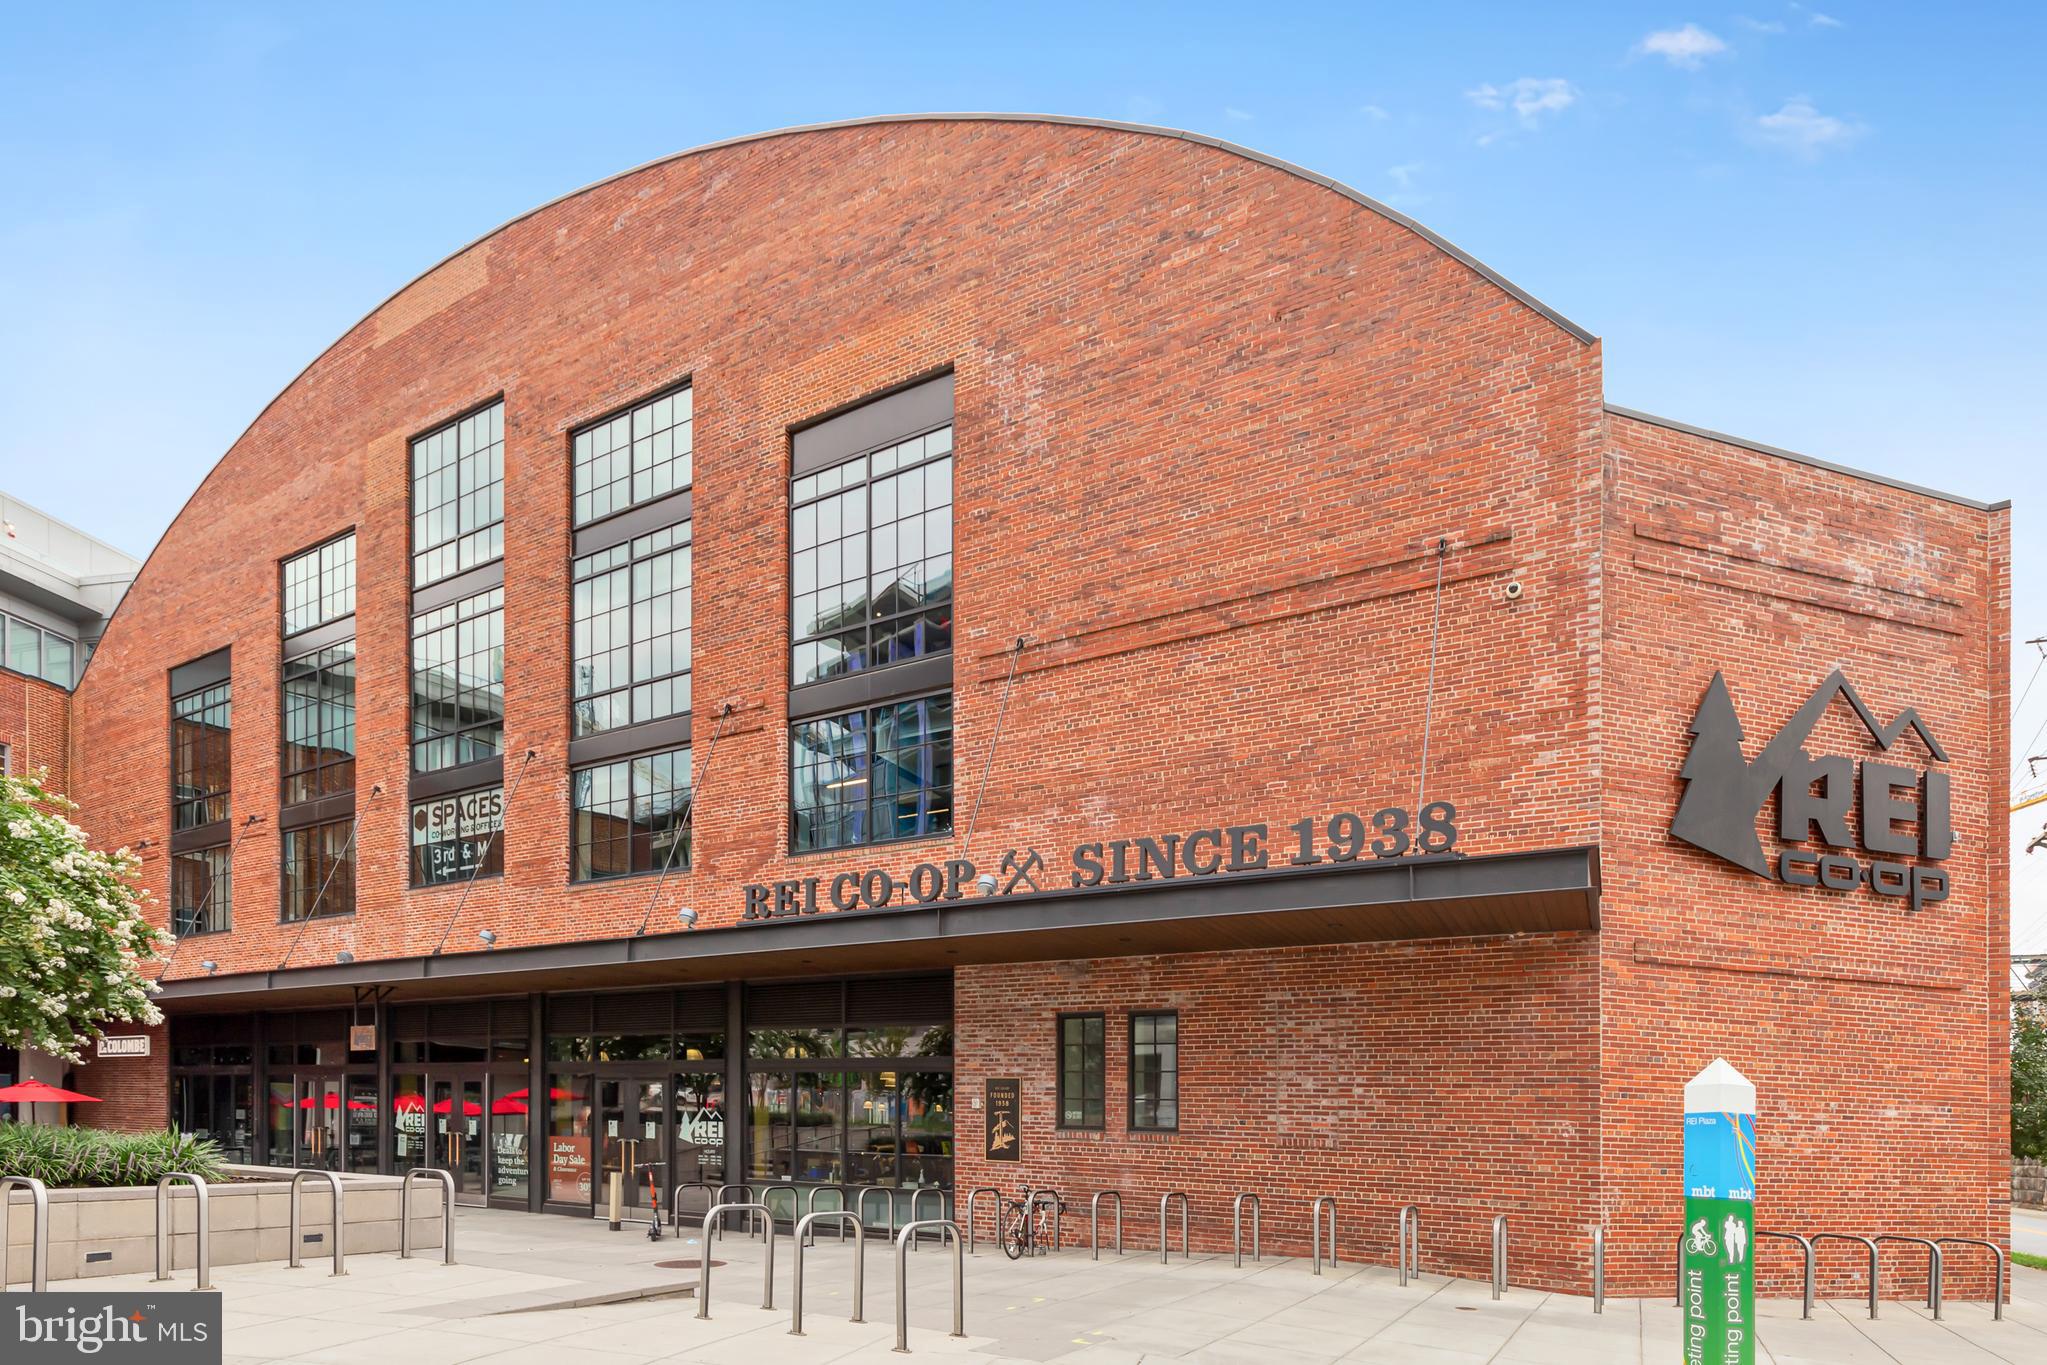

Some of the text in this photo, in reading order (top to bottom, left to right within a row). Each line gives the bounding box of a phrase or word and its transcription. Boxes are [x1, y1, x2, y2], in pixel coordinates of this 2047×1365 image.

[432, 794, 502, 827] SPACES
[1781, 750, 1950, 860] REI
[432, 826, 469, 838] CO-WORNG
[462, 844, 471, 859] &
[477, 841, 488, 857] M
[742, 801, 1457, 919] REI CO-OP SINCE 1938
[107, 1039, 145, 1053] COLOMBE
[405, 1113, 425, 1127] REI
[695, 1121, 724, 1138] REI
[553, 1142, 575, 1152] Labor
[498, 1155, 525, 1166] keep the
[553, 1154, 585, 1166] Day Sale
[498, 1166, 528, 1175] adventur
[498, 1177, 516, 1186] going
[1691, 1185, 1716, 1198] mbt
[1728, 1188, 1752, 1200] mbt
[1687, 1269, 1705, 1319] point
[1724, 1273, 1743, 1323] point
